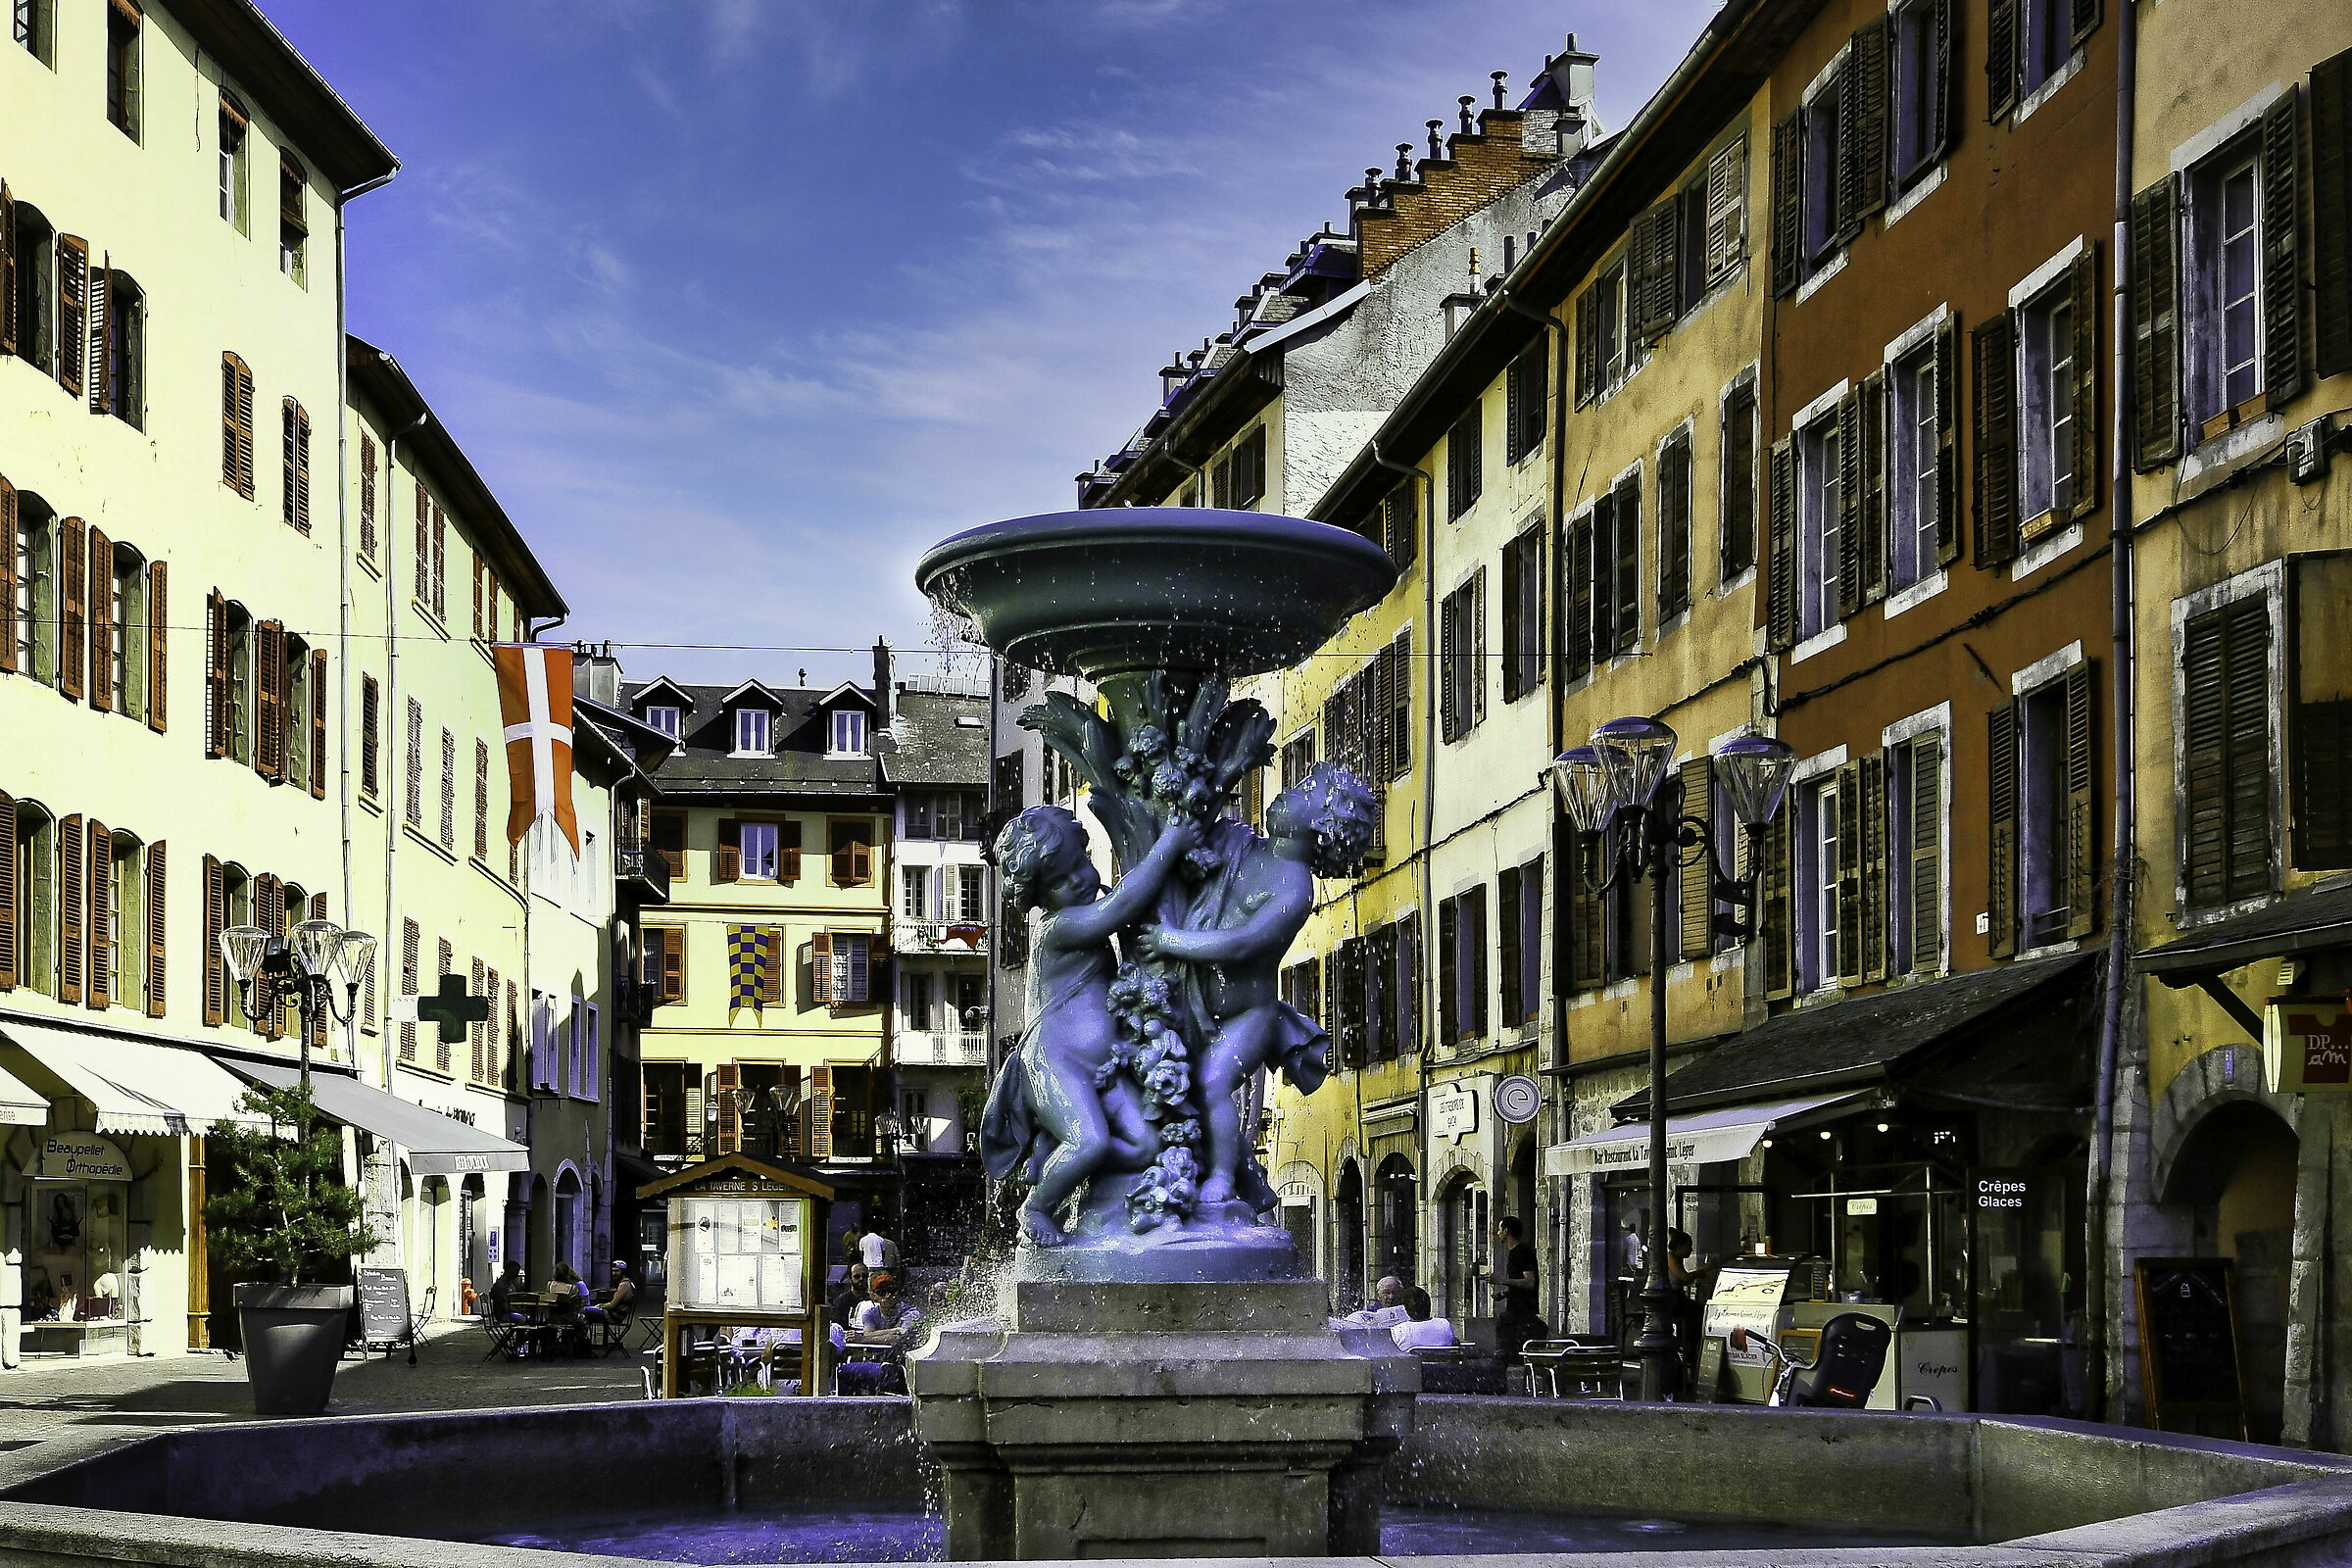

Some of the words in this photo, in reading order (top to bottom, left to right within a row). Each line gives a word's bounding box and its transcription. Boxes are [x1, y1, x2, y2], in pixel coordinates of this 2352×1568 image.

[47, 1139, 106, 1156] Beaupellet
[1593, 1149, 1603, 1165] Bar
[1603, 1147, 1632, 1163] Restaurant
[1679, 1141, 1695, 1160] Léger
[66, 1157, 123, 1176] Orthopédie
[710, 1181, 746, 1192] TAVERNE
[1978, 1180, 2026, 1195] Crêpes
[1978, 1196, 2023, 1207] Glaces
